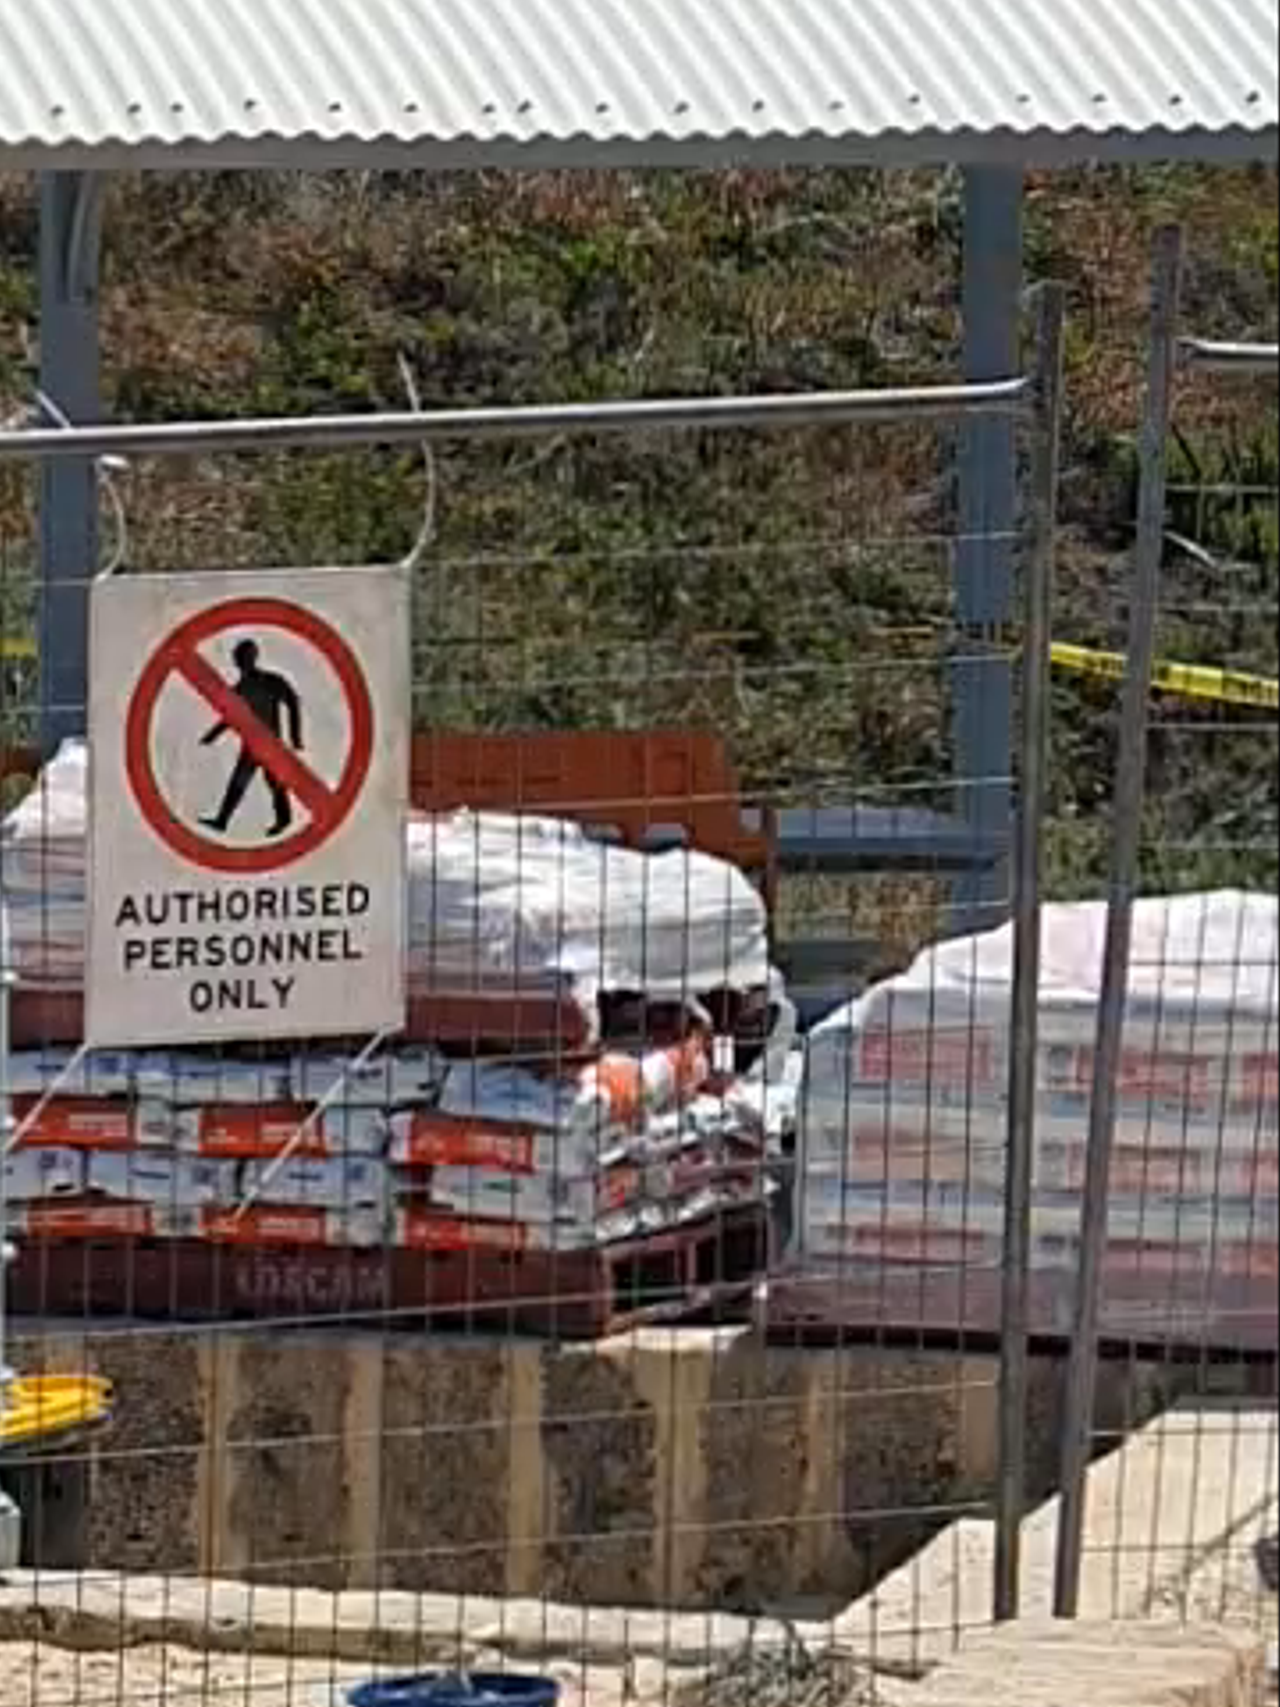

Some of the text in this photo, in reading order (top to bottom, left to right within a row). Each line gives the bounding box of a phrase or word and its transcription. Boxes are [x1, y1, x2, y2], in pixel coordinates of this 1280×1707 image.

[115, 882, 371, 926] AUTHORISED
[123, 929, 363, 971] PERSONNEL
[188, 977, 296, 1014] ONLY
